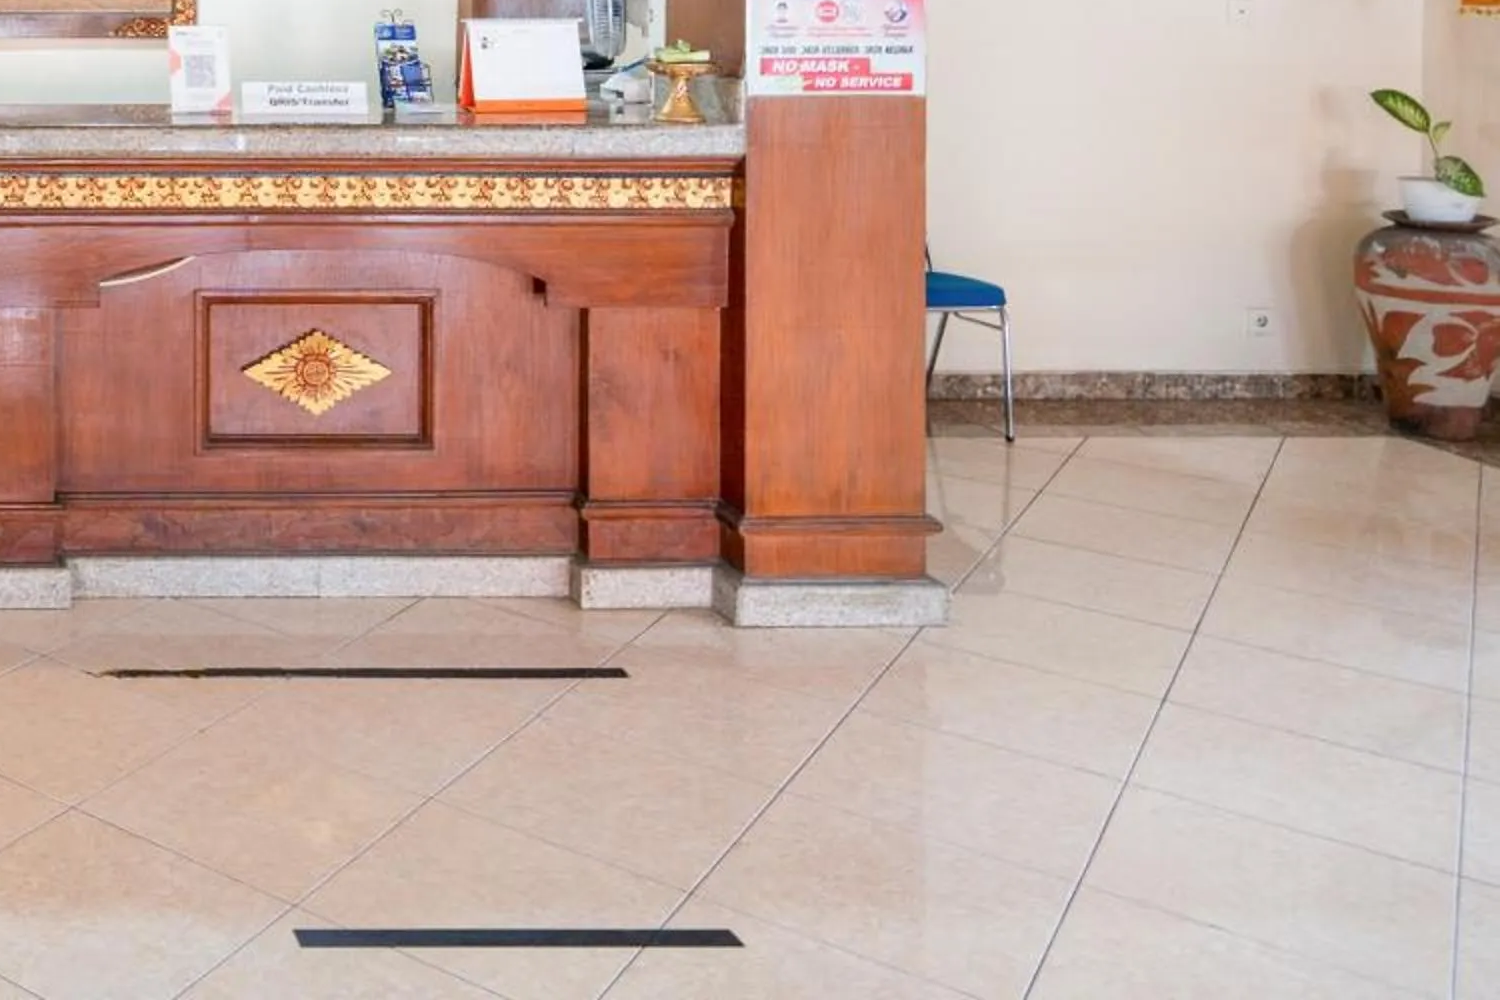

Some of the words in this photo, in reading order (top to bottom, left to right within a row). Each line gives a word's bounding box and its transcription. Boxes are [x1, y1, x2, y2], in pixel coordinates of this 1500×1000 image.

[772, 59, 798, 73] NO
[800, 59, 849, 73] MASK
[814, 76, 836, 88] NO
[840, 76, 902, 88] SERVICE
